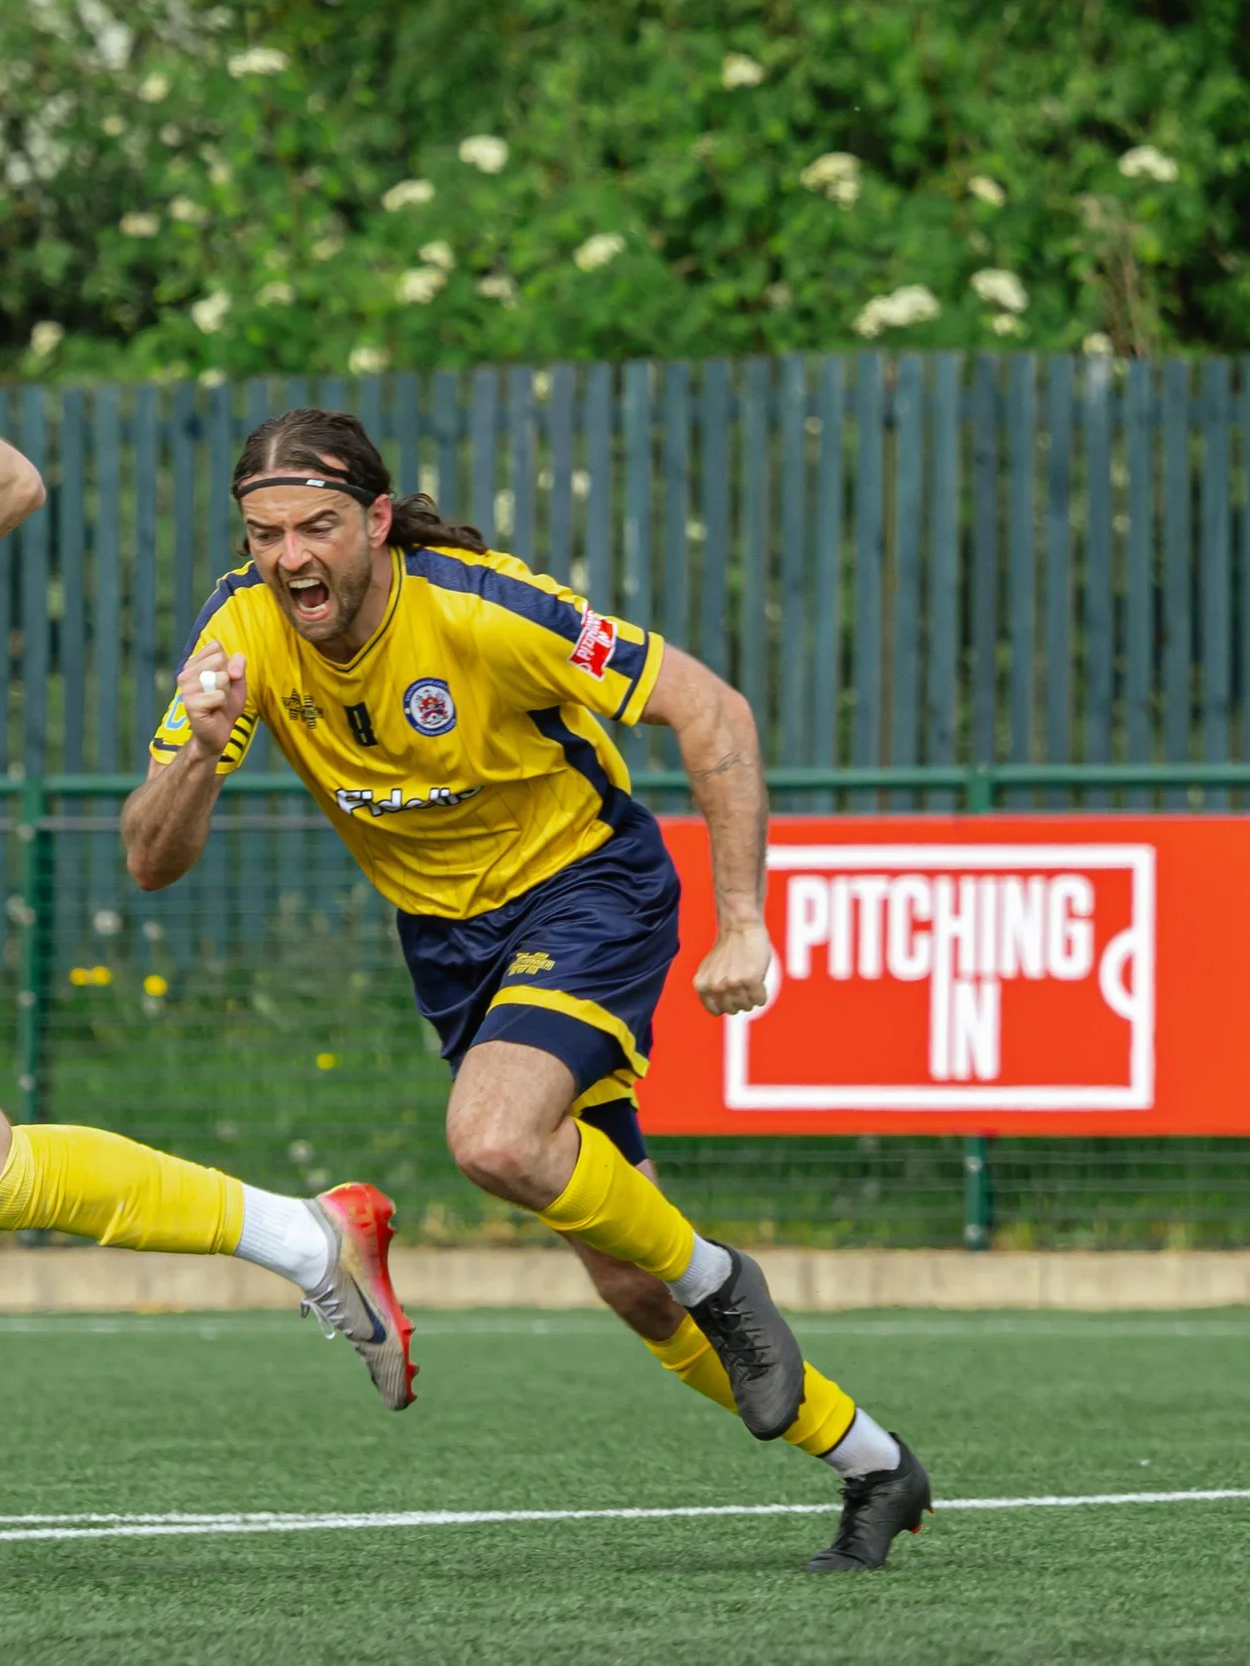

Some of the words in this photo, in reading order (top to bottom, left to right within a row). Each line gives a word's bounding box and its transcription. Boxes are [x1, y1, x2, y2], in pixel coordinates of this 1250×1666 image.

[342, 701, 379, 747] 8
[786, 873, 1095, 981] PITCHING
[928, 980, 1002, 1081] IN
